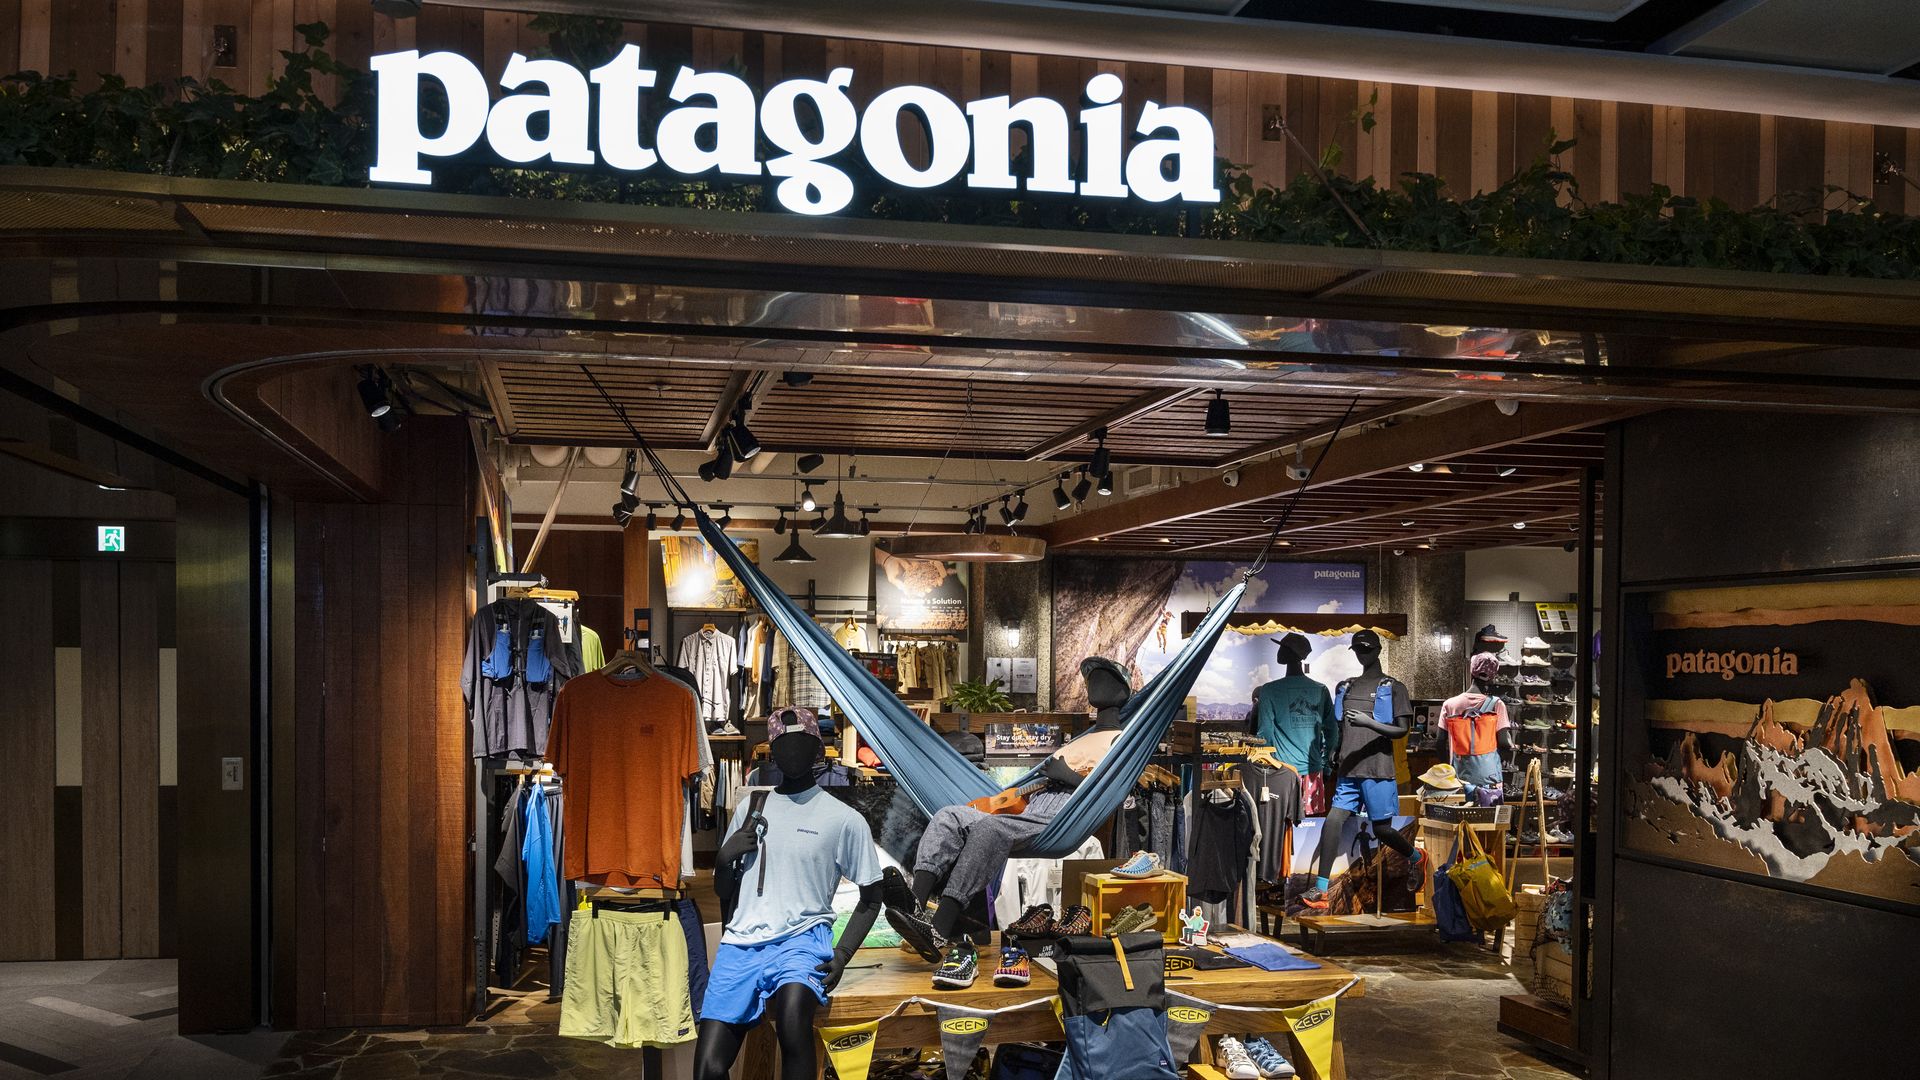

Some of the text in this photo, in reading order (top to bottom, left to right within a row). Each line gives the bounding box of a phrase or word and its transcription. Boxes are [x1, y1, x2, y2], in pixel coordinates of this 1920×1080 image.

[369, 43, 1221, 216] patagonia
[1314, 569, 1360, 580] patagonia
[1666, 646, 1798, 681] patagonia
[996, 734, 1011, 742] Stay
[1040, 734, 1052, 742] dry
[1165, 958, 1192, 970] EEN
[1169, 1009, 1208, 1021] KEEN
[1294, 1009, 1331, 1032] KEEN
[943, 1020, 986, 1031] KEEN
[829, 1031, 873, 1051] KEEN
